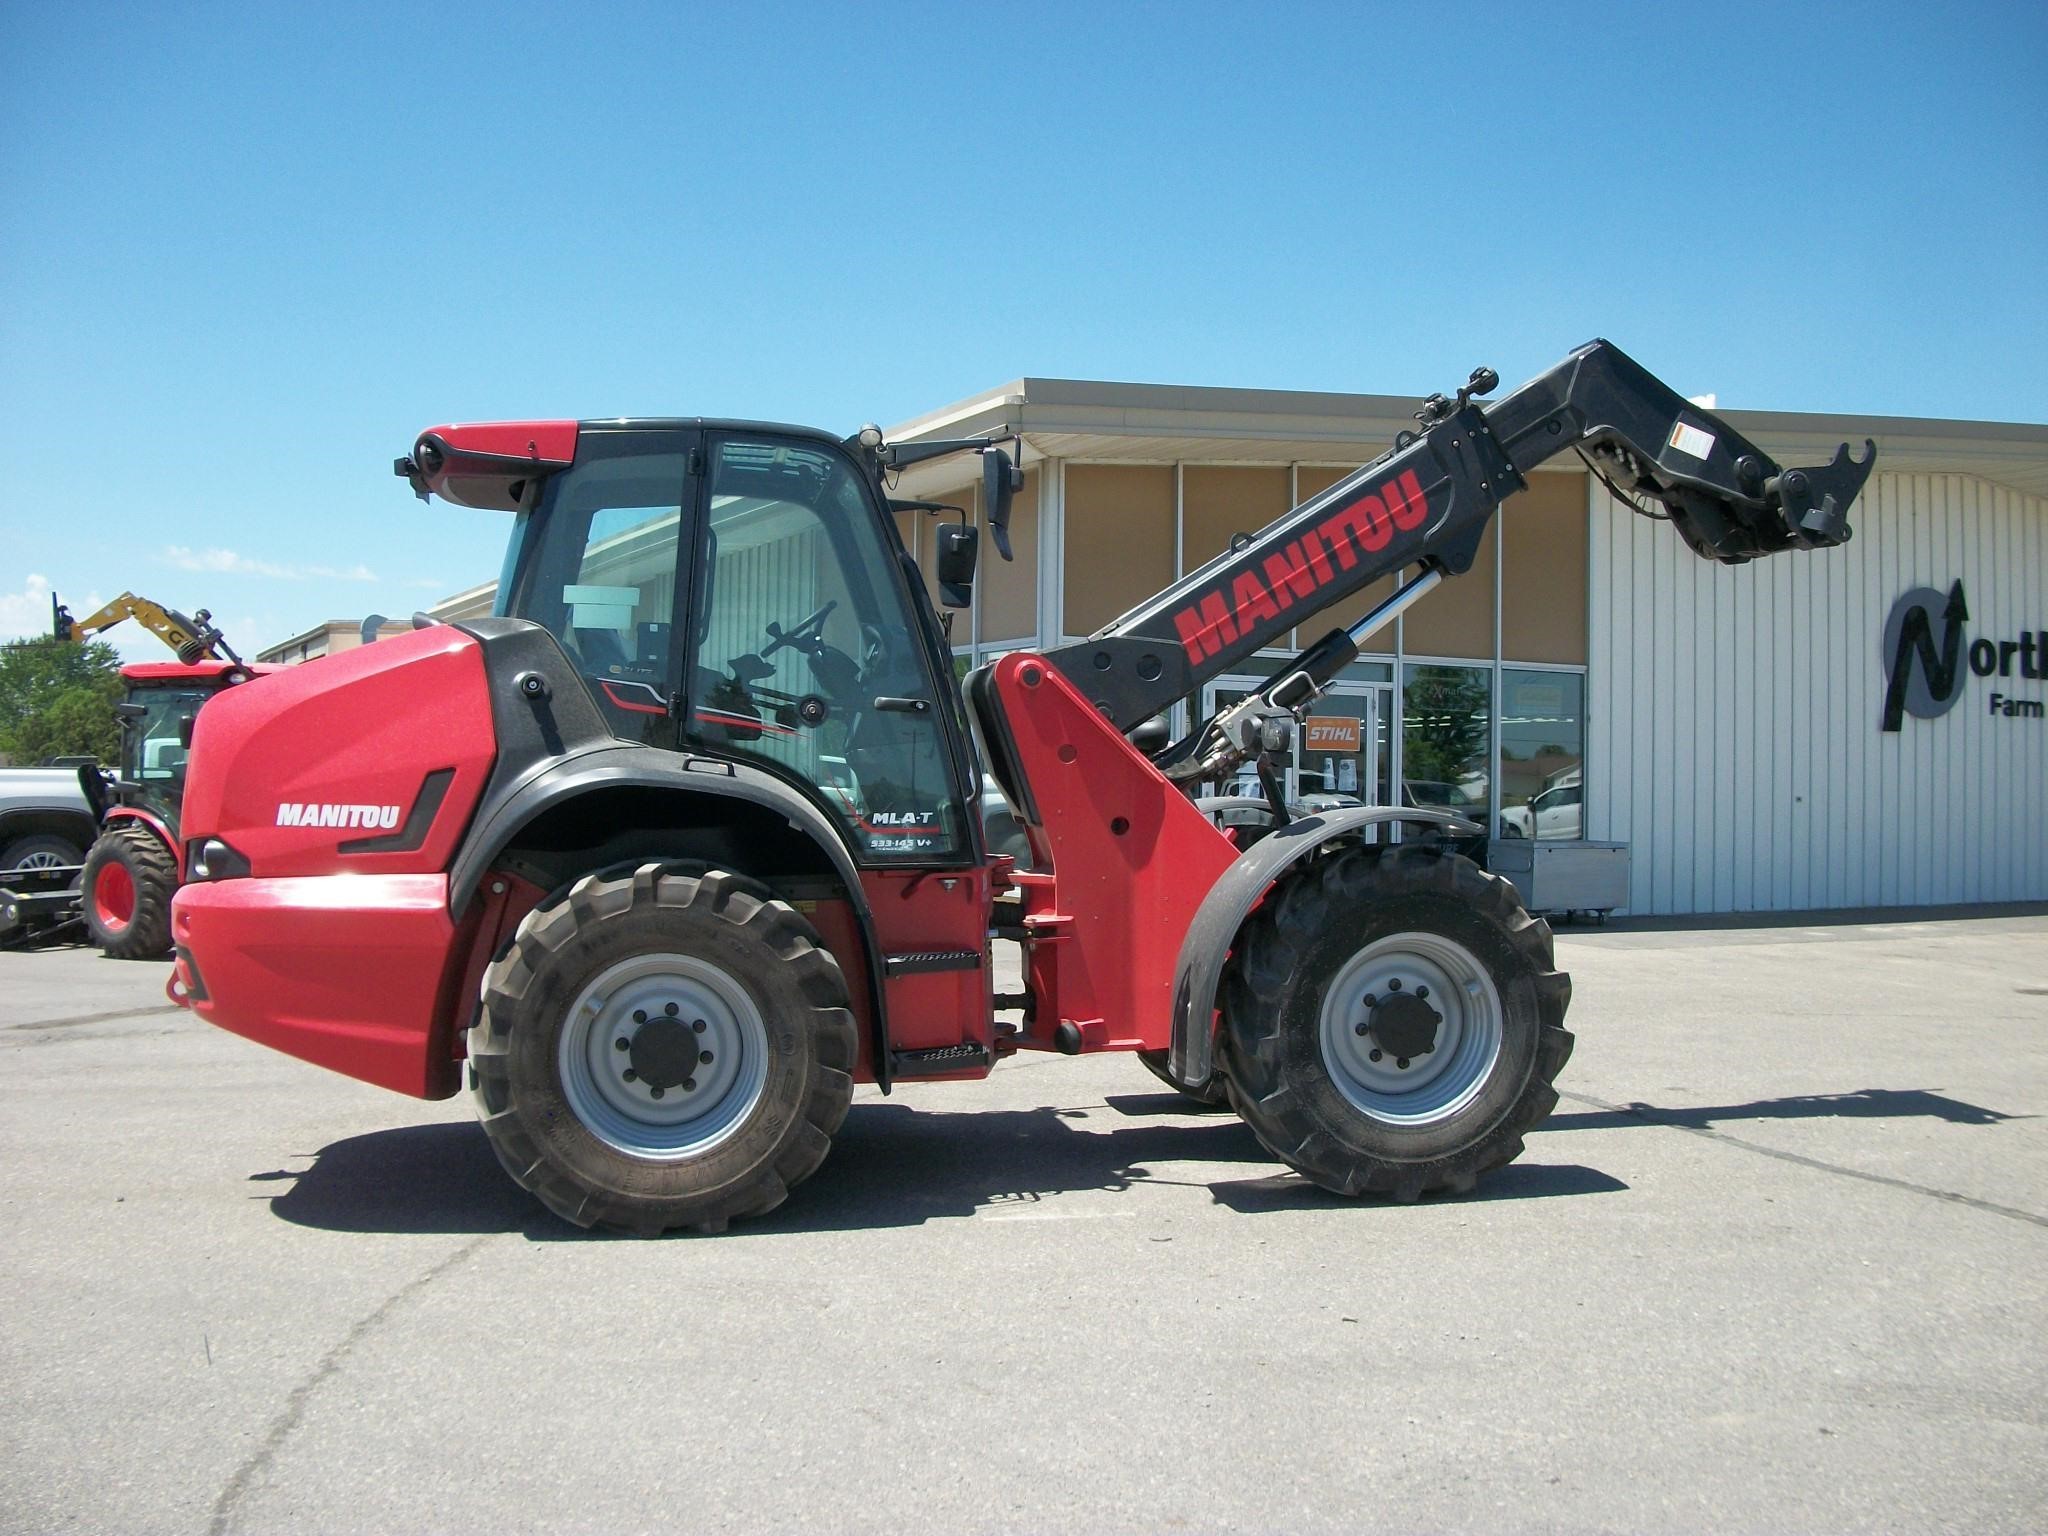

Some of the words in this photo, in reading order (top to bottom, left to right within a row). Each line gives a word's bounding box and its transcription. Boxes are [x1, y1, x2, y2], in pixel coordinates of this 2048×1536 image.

[1173, 469, 1428, 666] MANITOU
[1989, 693, 2045, 718] Farm
[1310, 727, 1355, 741] STIHL
[276, 803, 400, 828] MANITOU
[872, 812, 934, 824] MLA-T
[916, 839, 932, 847] V+
